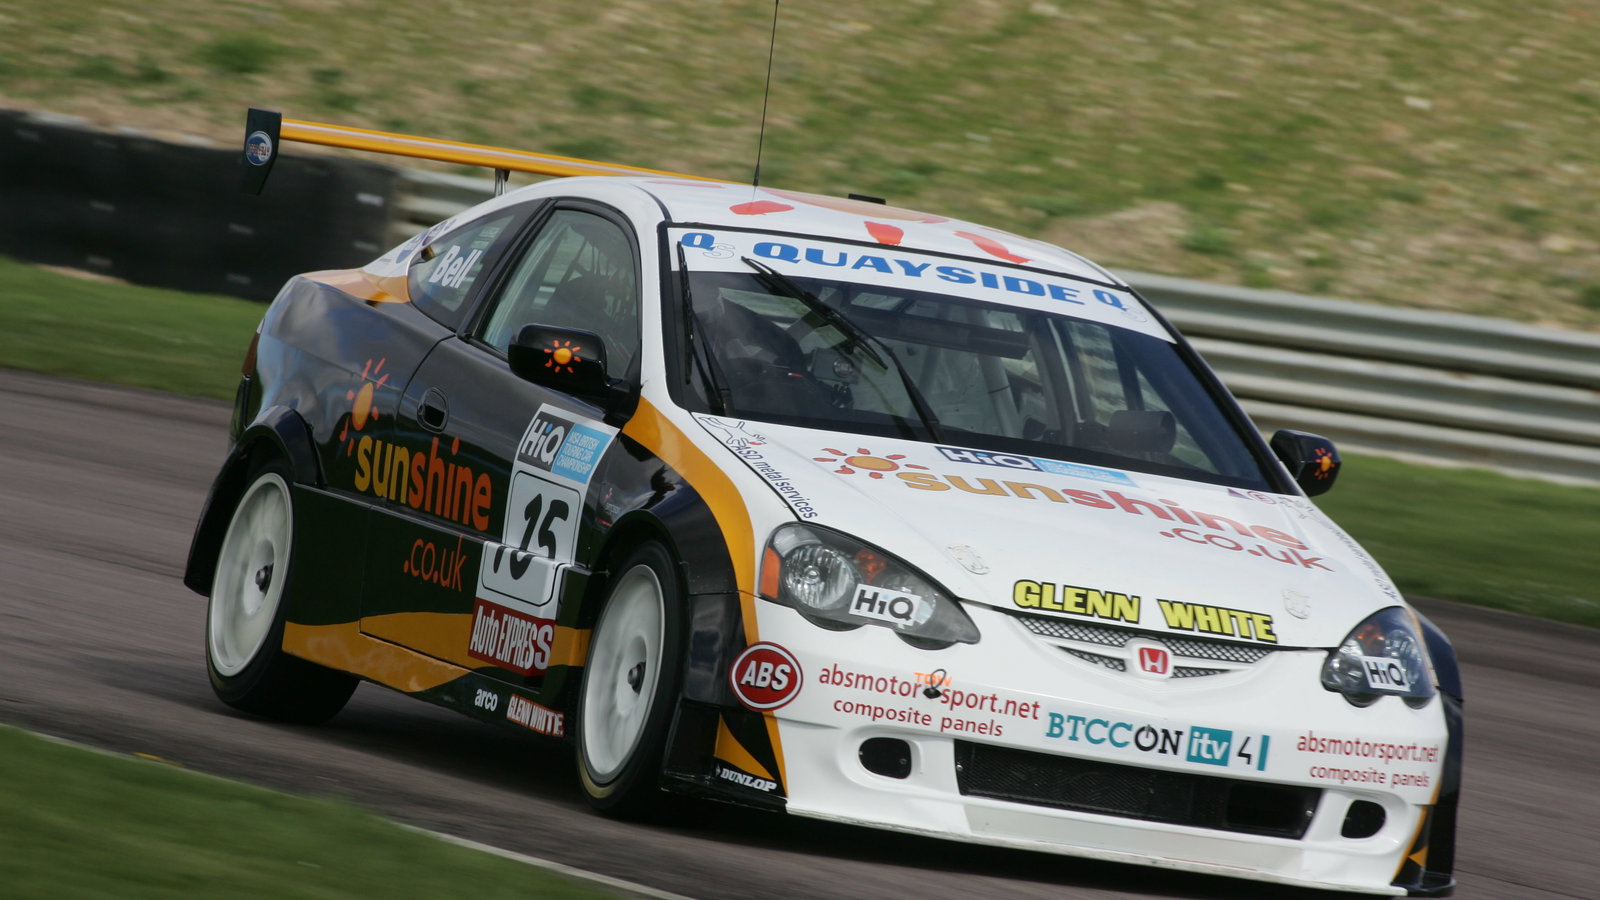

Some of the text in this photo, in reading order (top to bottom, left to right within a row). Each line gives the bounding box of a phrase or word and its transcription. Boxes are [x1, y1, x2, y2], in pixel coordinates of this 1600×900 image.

[428, 244, 483, 289] Bell
[753, 242, 1086, 306] QUAYSIDE
[520, 418, 566, 467] HiQ
[940, 447, 1036, 472] HiQ
[354, 435, 493, 532] sunshine
[730, 445, 819, 519] ASD metal services
[896, 472, 1310, 551] sunshine
[492, 493, 570, 581] 15
[403, 534, 467, 592] .co.uk
[854, 588, 915, 621] HiQ
[1013, 579, 1277, 644] GLENN WHITE
[469, 605, 554, 671] Auto EXPRESS
[740, 660, 792, 692] ABS
[1364, 661, 1405, 686] HiQ
[474, 688, 498, 712] arco
[833, 698, 1003, 737] composite panels
[1190, 730, 1229, 761] itv
[1296, 730, 1440, 765] absmotorsport.net
[719, 767, 778, 793] DUNLOP
[1309, 764, 1431, 789] composite panels
